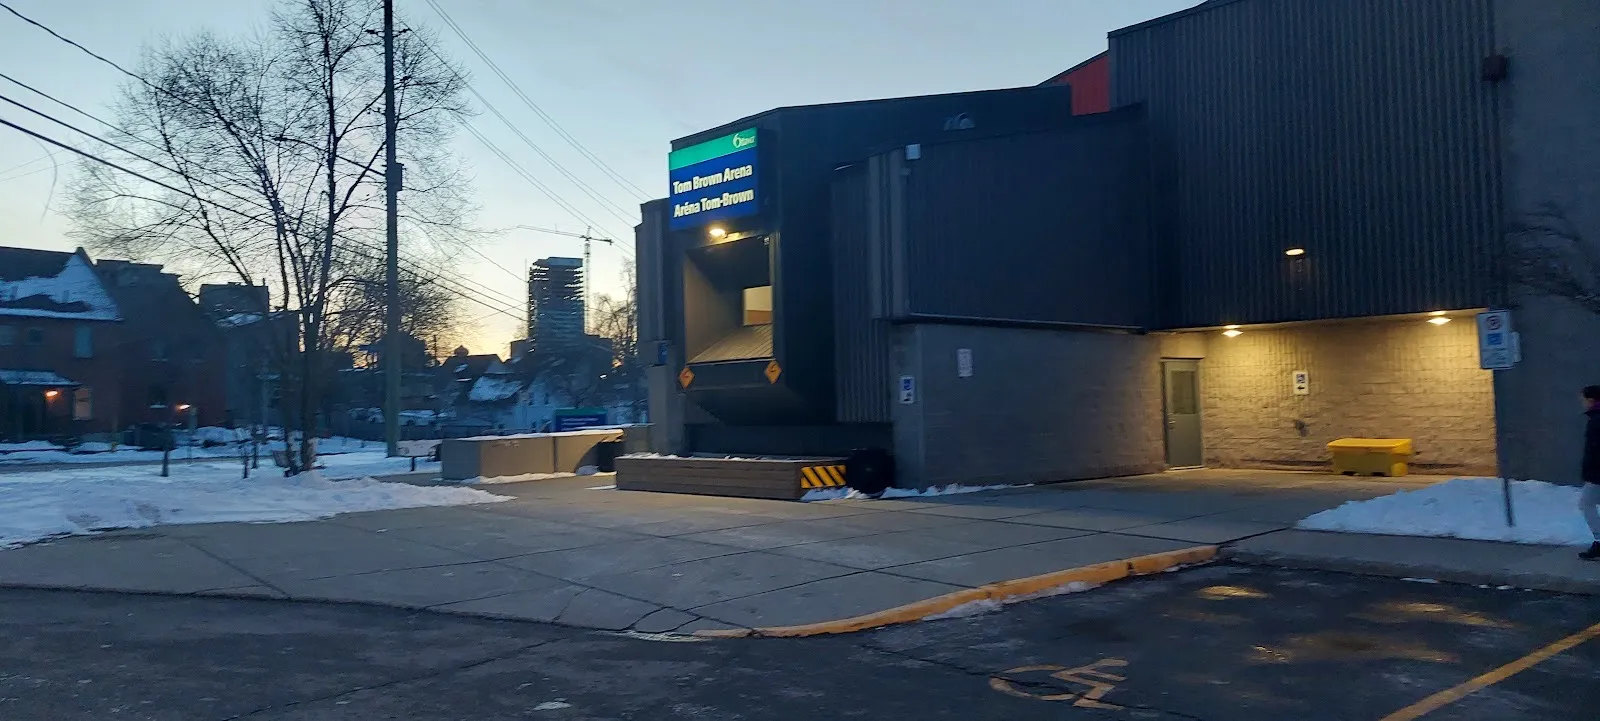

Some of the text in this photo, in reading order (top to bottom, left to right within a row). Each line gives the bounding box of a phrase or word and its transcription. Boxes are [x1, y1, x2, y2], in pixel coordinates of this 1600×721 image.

[673, 164, 753, 194] Tom Brown Arena
[674, 189, 754, 217] Aréna Tom-Brown
